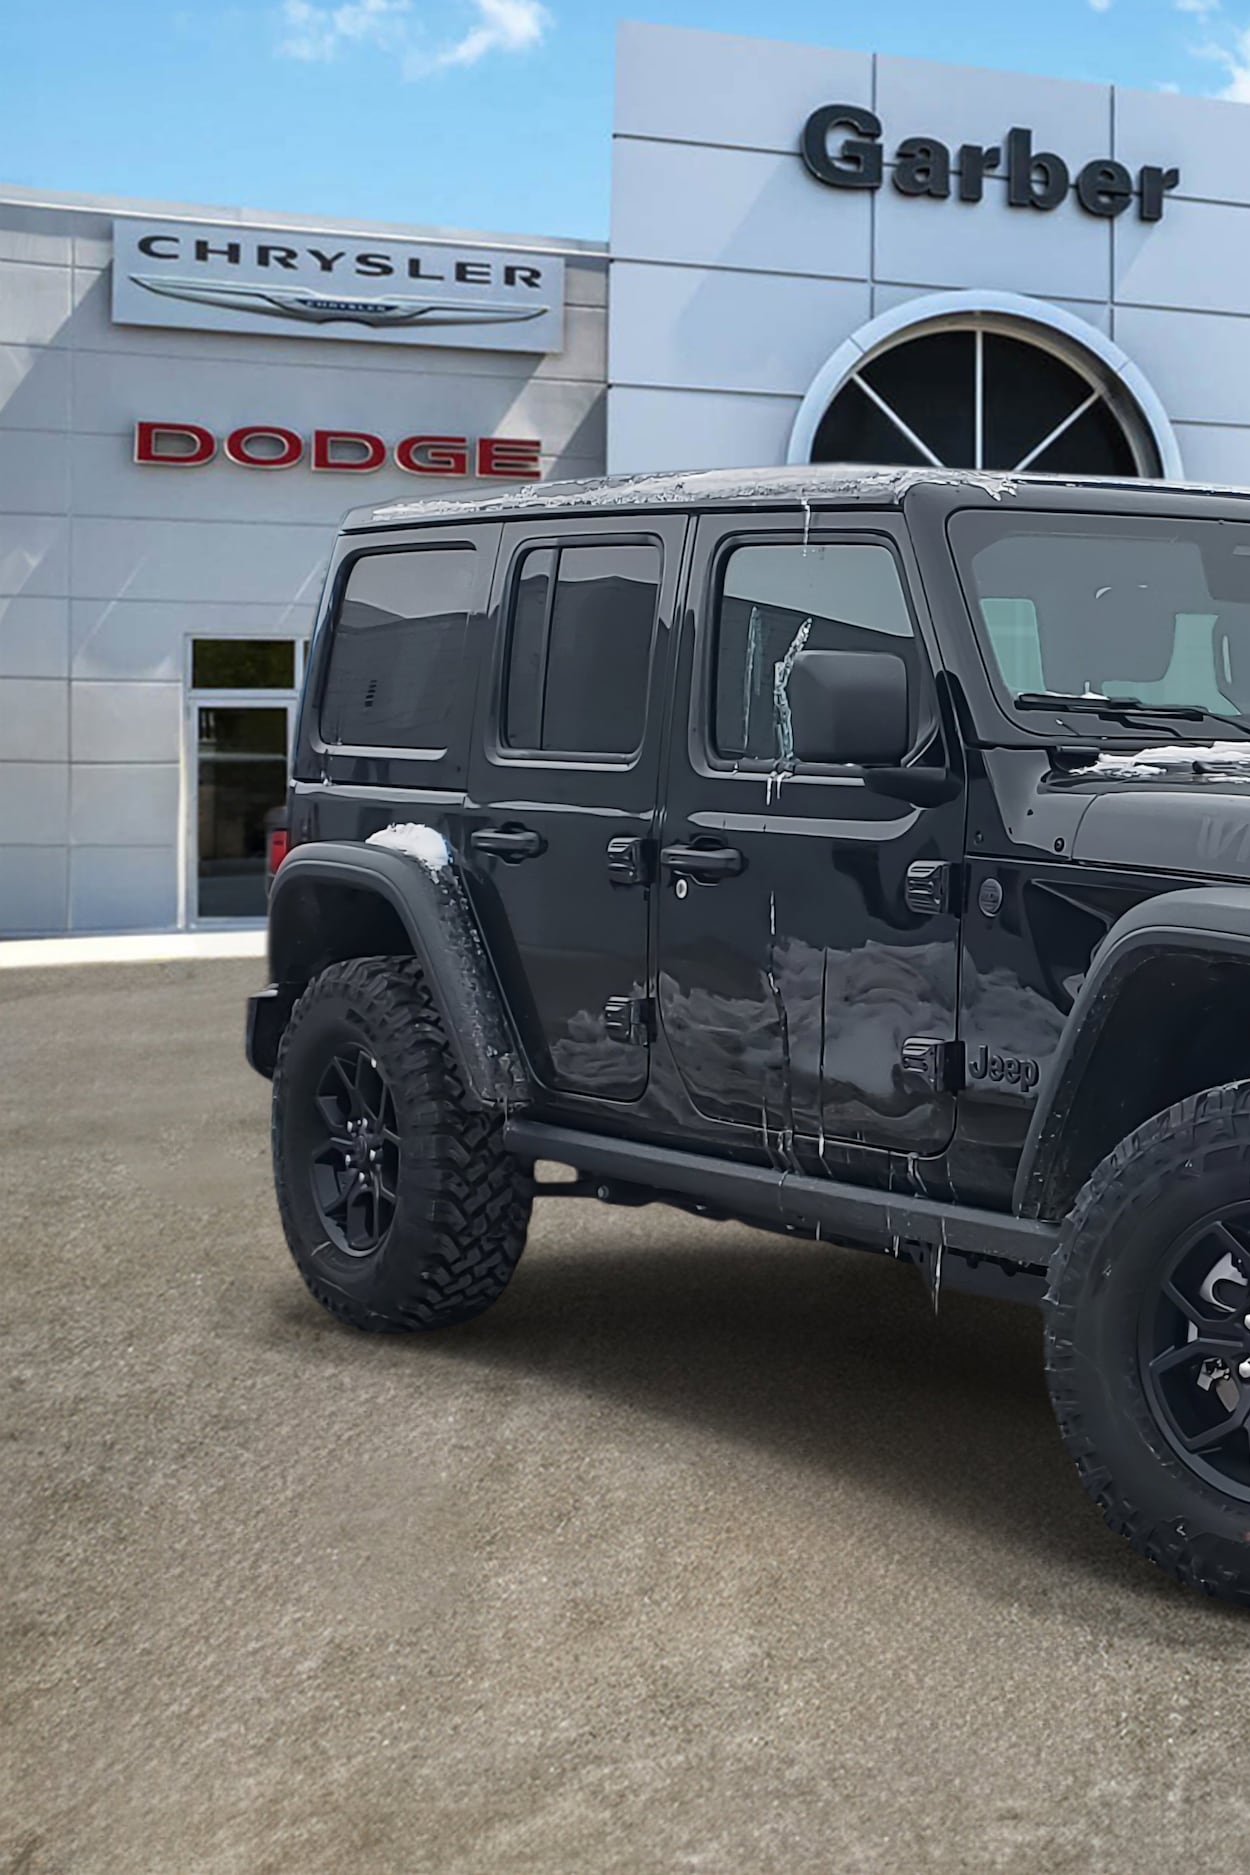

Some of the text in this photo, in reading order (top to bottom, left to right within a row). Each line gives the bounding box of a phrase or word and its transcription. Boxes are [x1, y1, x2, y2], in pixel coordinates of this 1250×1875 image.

[801, 103, 1180, 222] Garber
[138, 235, 542, 289] CHRYSLER
[133, 421, 543, 480] DODGE
[968, 1044, 1040, 1093] Jeep
